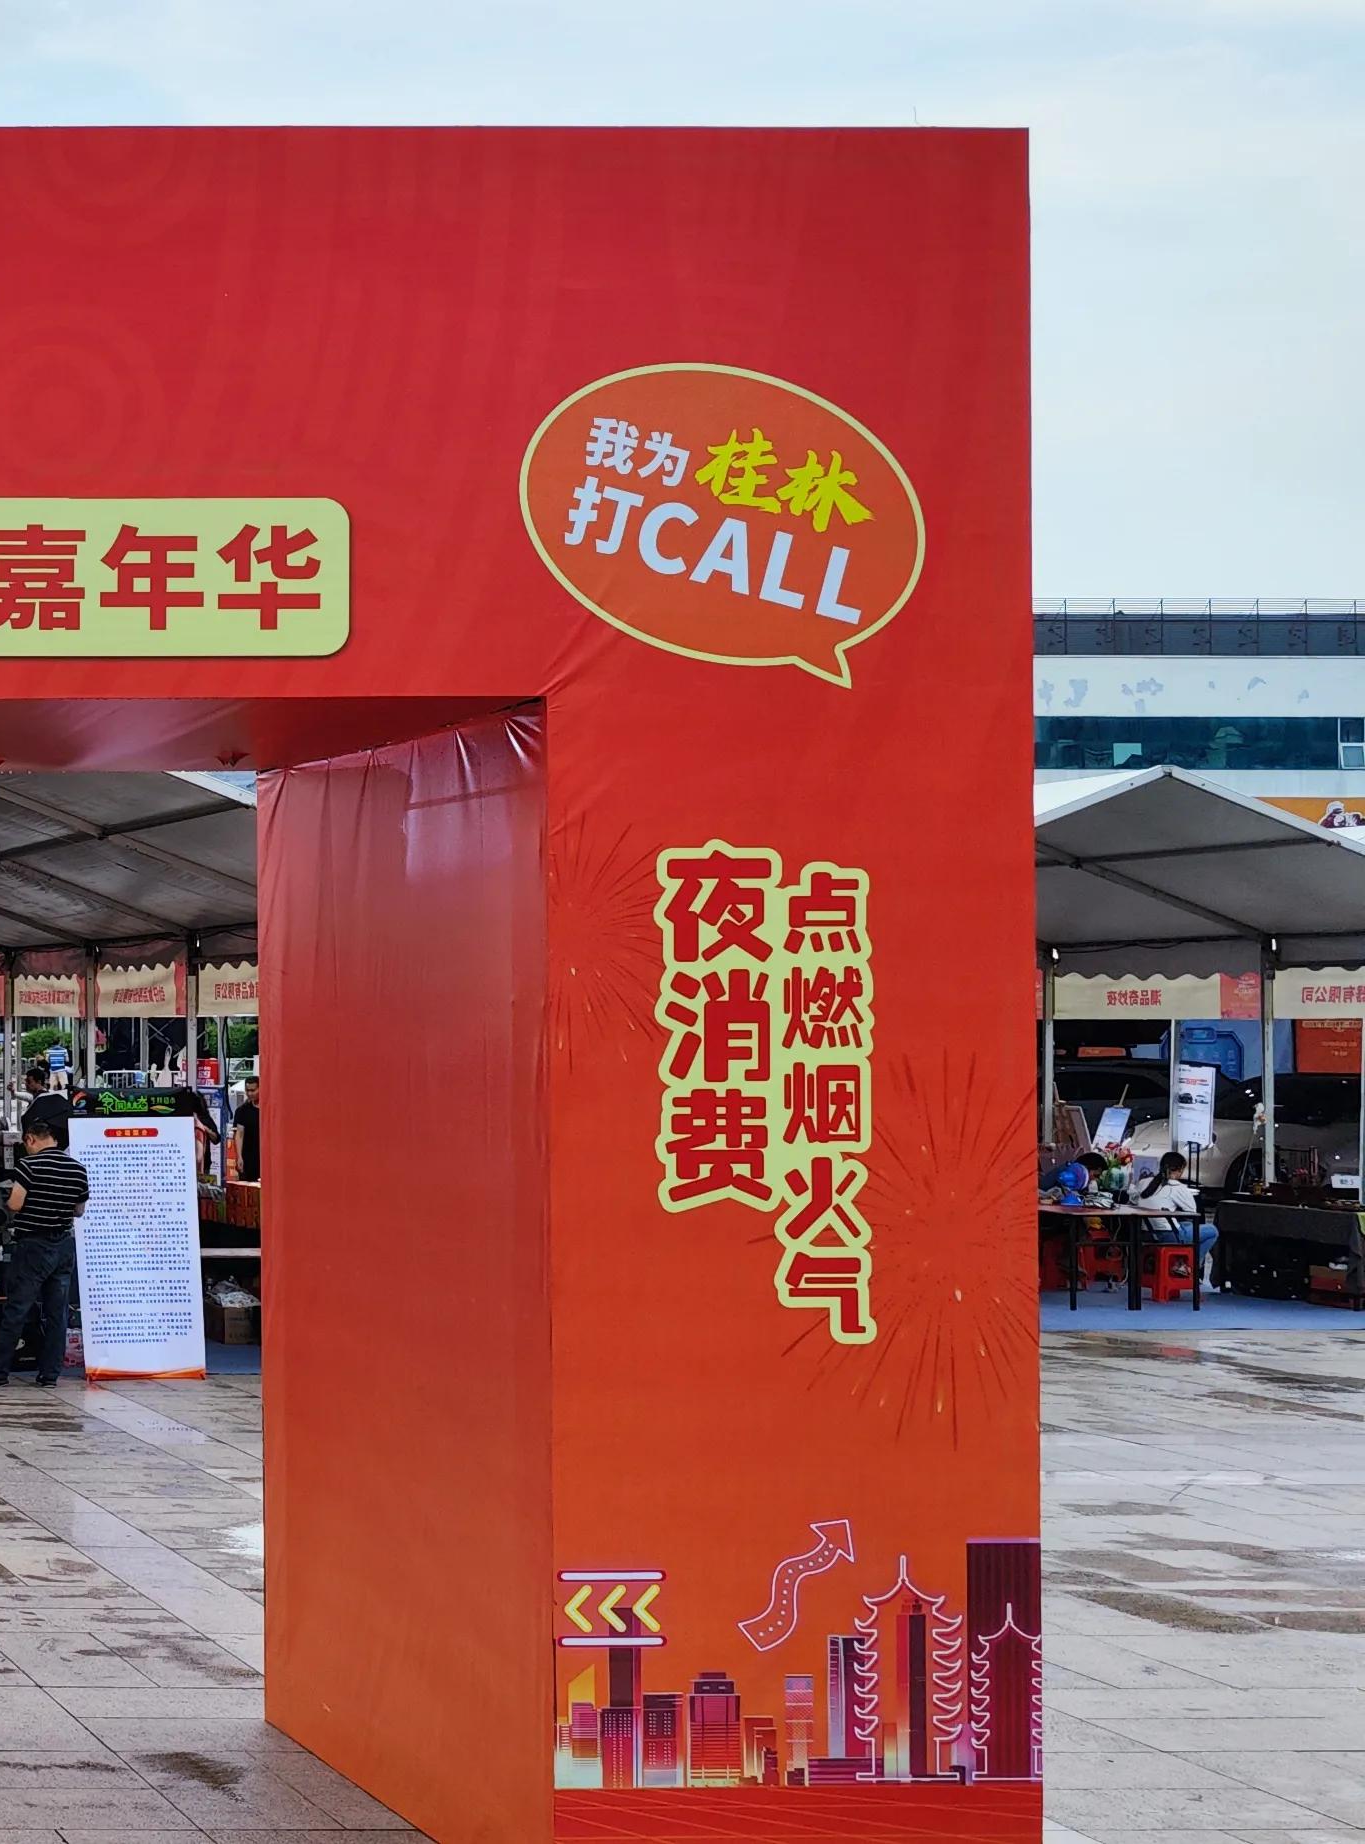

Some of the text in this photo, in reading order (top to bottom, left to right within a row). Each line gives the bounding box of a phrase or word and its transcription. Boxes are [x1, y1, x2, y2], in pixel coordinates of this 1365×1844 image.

[564, 475, 862, 625] 打CALL
[584, 416, 876, 533] 我为桂林
[664, 849, 774, 1202] 夜消费
[782, 871, 867, 1334] 点燃烟火气
